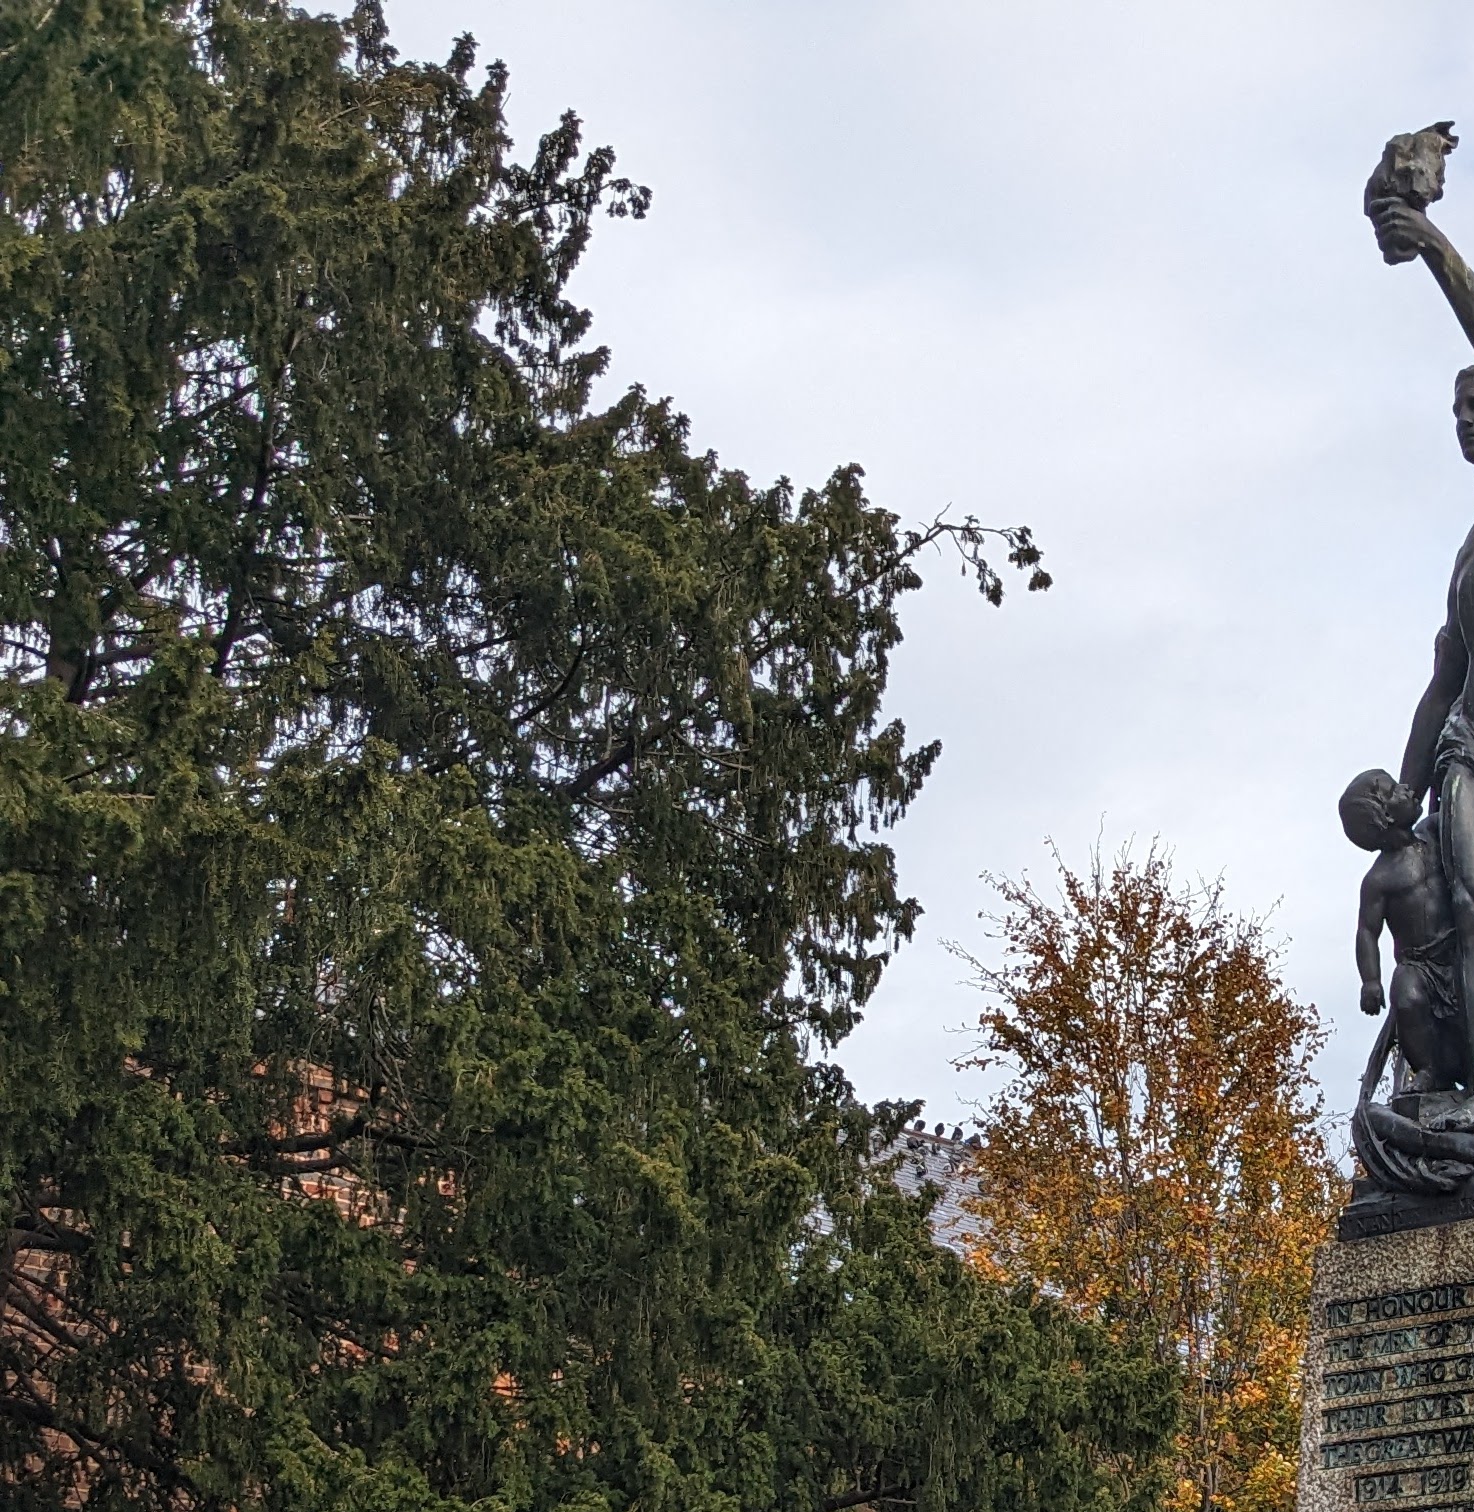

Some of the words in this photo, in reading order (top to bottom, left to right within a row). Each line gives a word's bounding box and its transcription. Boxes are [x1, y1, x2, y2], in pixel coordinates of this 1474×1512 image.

[1366, 1286, 1466, 1319] HONOUR
[1327, 1338, 1363, 1361] THE
[1372, 1330, 1417, 1358] MEN
[1427, 1324, 1452, 1348] OF
[1324, 1372, 1382, 1398] TOWN
[1394, 1362, 1446, 1389] WHO
[1322, 1407, 1387, 1432] THEIR
[1403, 1396, 1466, 1424] LIVES
[1322, 1445, 1360, 1468] THE
[1366, 1433, 1437, 1462] GREAT
[1356, 1476, 1402, 1501] 1914
